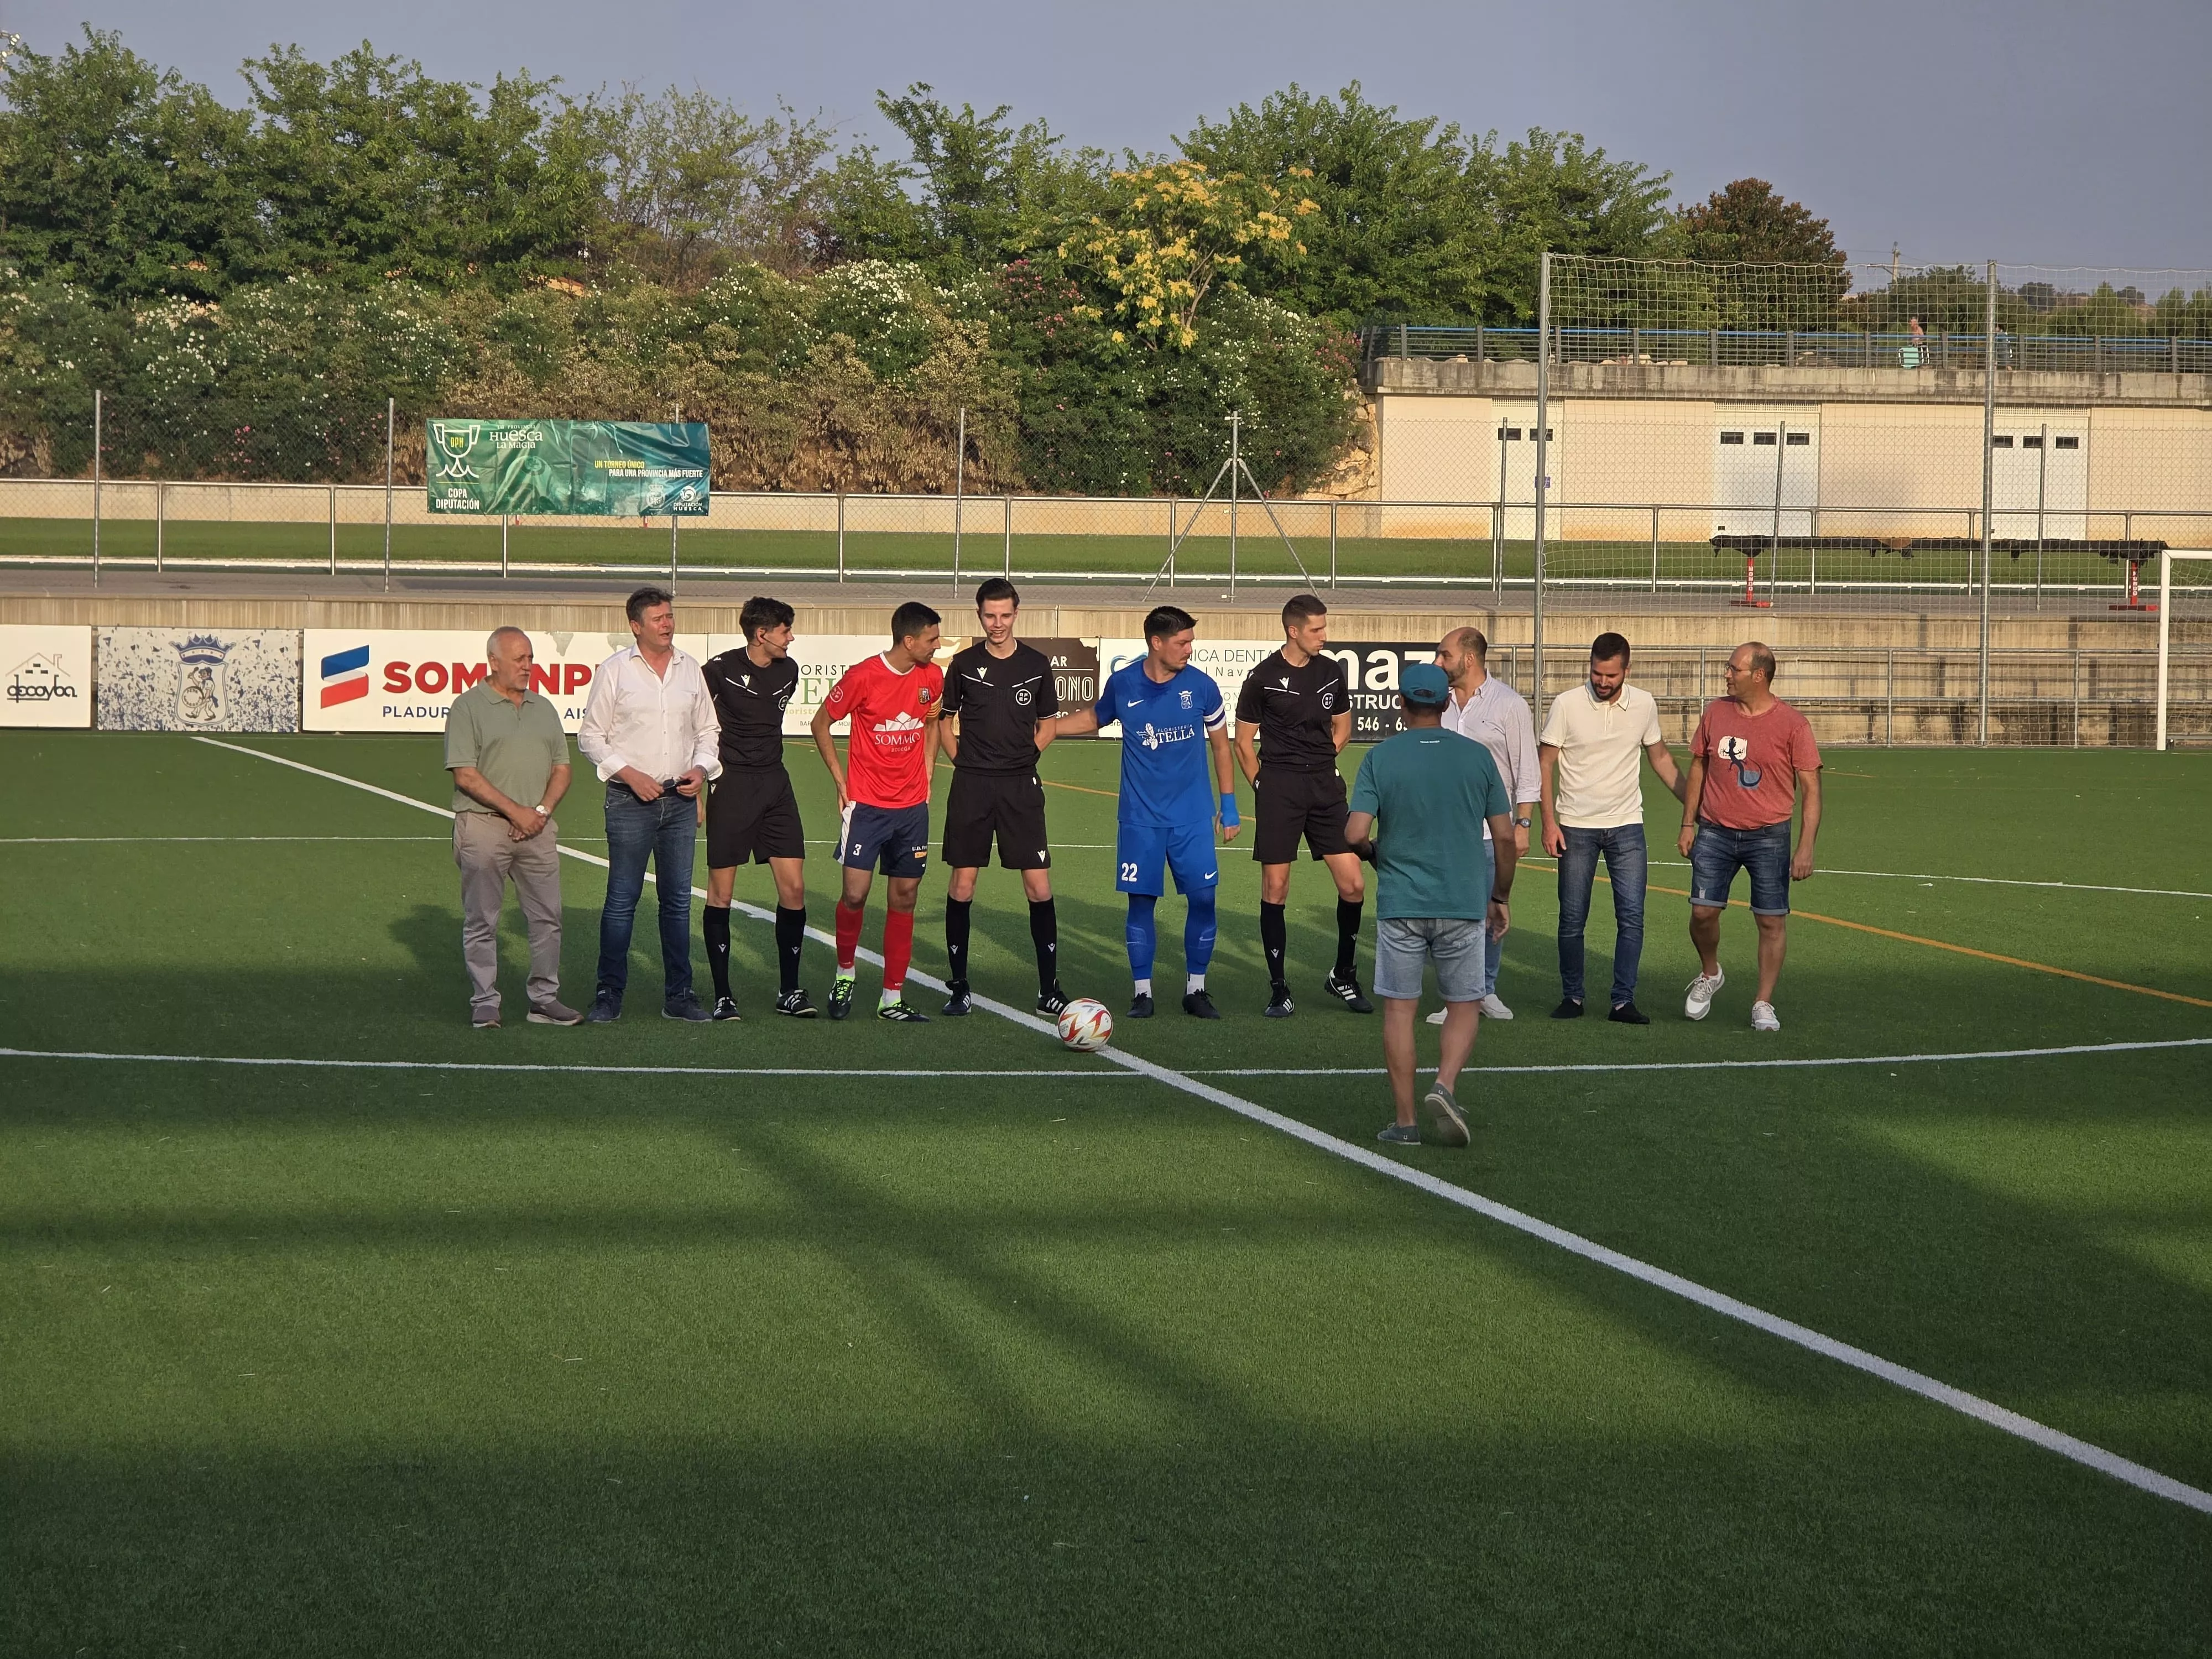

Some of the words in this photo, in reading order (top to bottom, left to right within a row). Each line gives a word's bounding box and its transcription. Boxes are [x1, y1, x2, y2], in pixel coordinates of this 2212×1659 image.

[450, 437, 463, 448] DPH
[604, 460, 626, 468] TORNEO
[627, 460, 644, 468] ÚNICO
[609, 469, 624, 477] PARA
[625, 469, 637, 477] UNA
[638, 469, 668, 478] PROVINCIA
[682, 469, 703, 478] FUERTE
[448, 488, 467, 498] COPA
[436, 498, 479, 509] DIPUTACIÓN
[1051, 656, 1067, 667] AR
[1055, 676, 1094, 701] ONO
[1357, 717, 1379, 731] 546
[1156, 727, 1195, 743] TELLA
[853, 843, 862, 856] 3
[1121, 862, 1138, 882] 22
